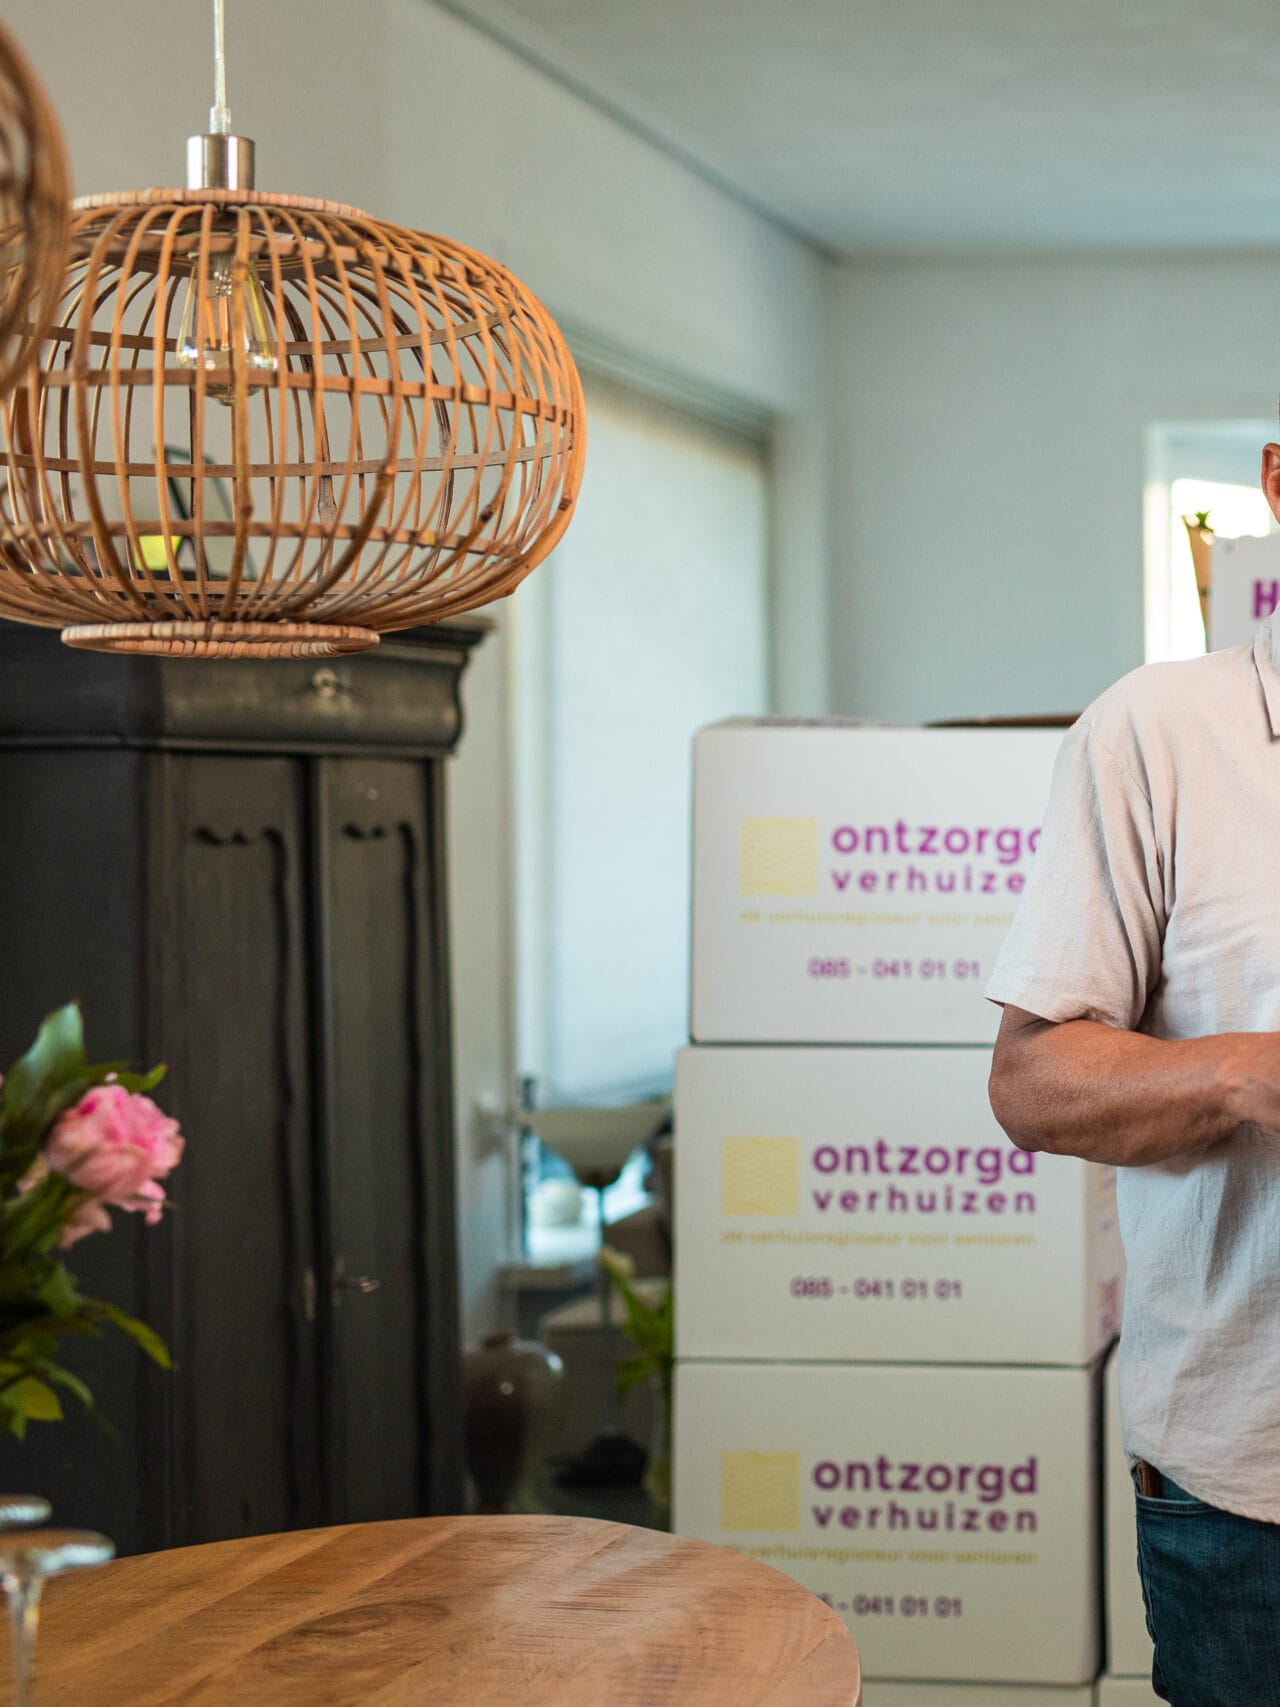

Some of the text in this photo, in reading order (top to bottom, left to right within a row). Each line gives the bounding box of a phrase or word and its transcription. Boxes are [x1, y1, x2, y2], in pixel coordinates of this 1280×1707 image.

[831, 864, 1026, 894] verhuize
[812, 1138, 1036, 1184] ontzorgd
[812, 1185, 1036, 1214] verhuizen
[812, 1456, 1038, 1502] ontzorgd
[812, 1502, 1038, 1532] verhuizen
